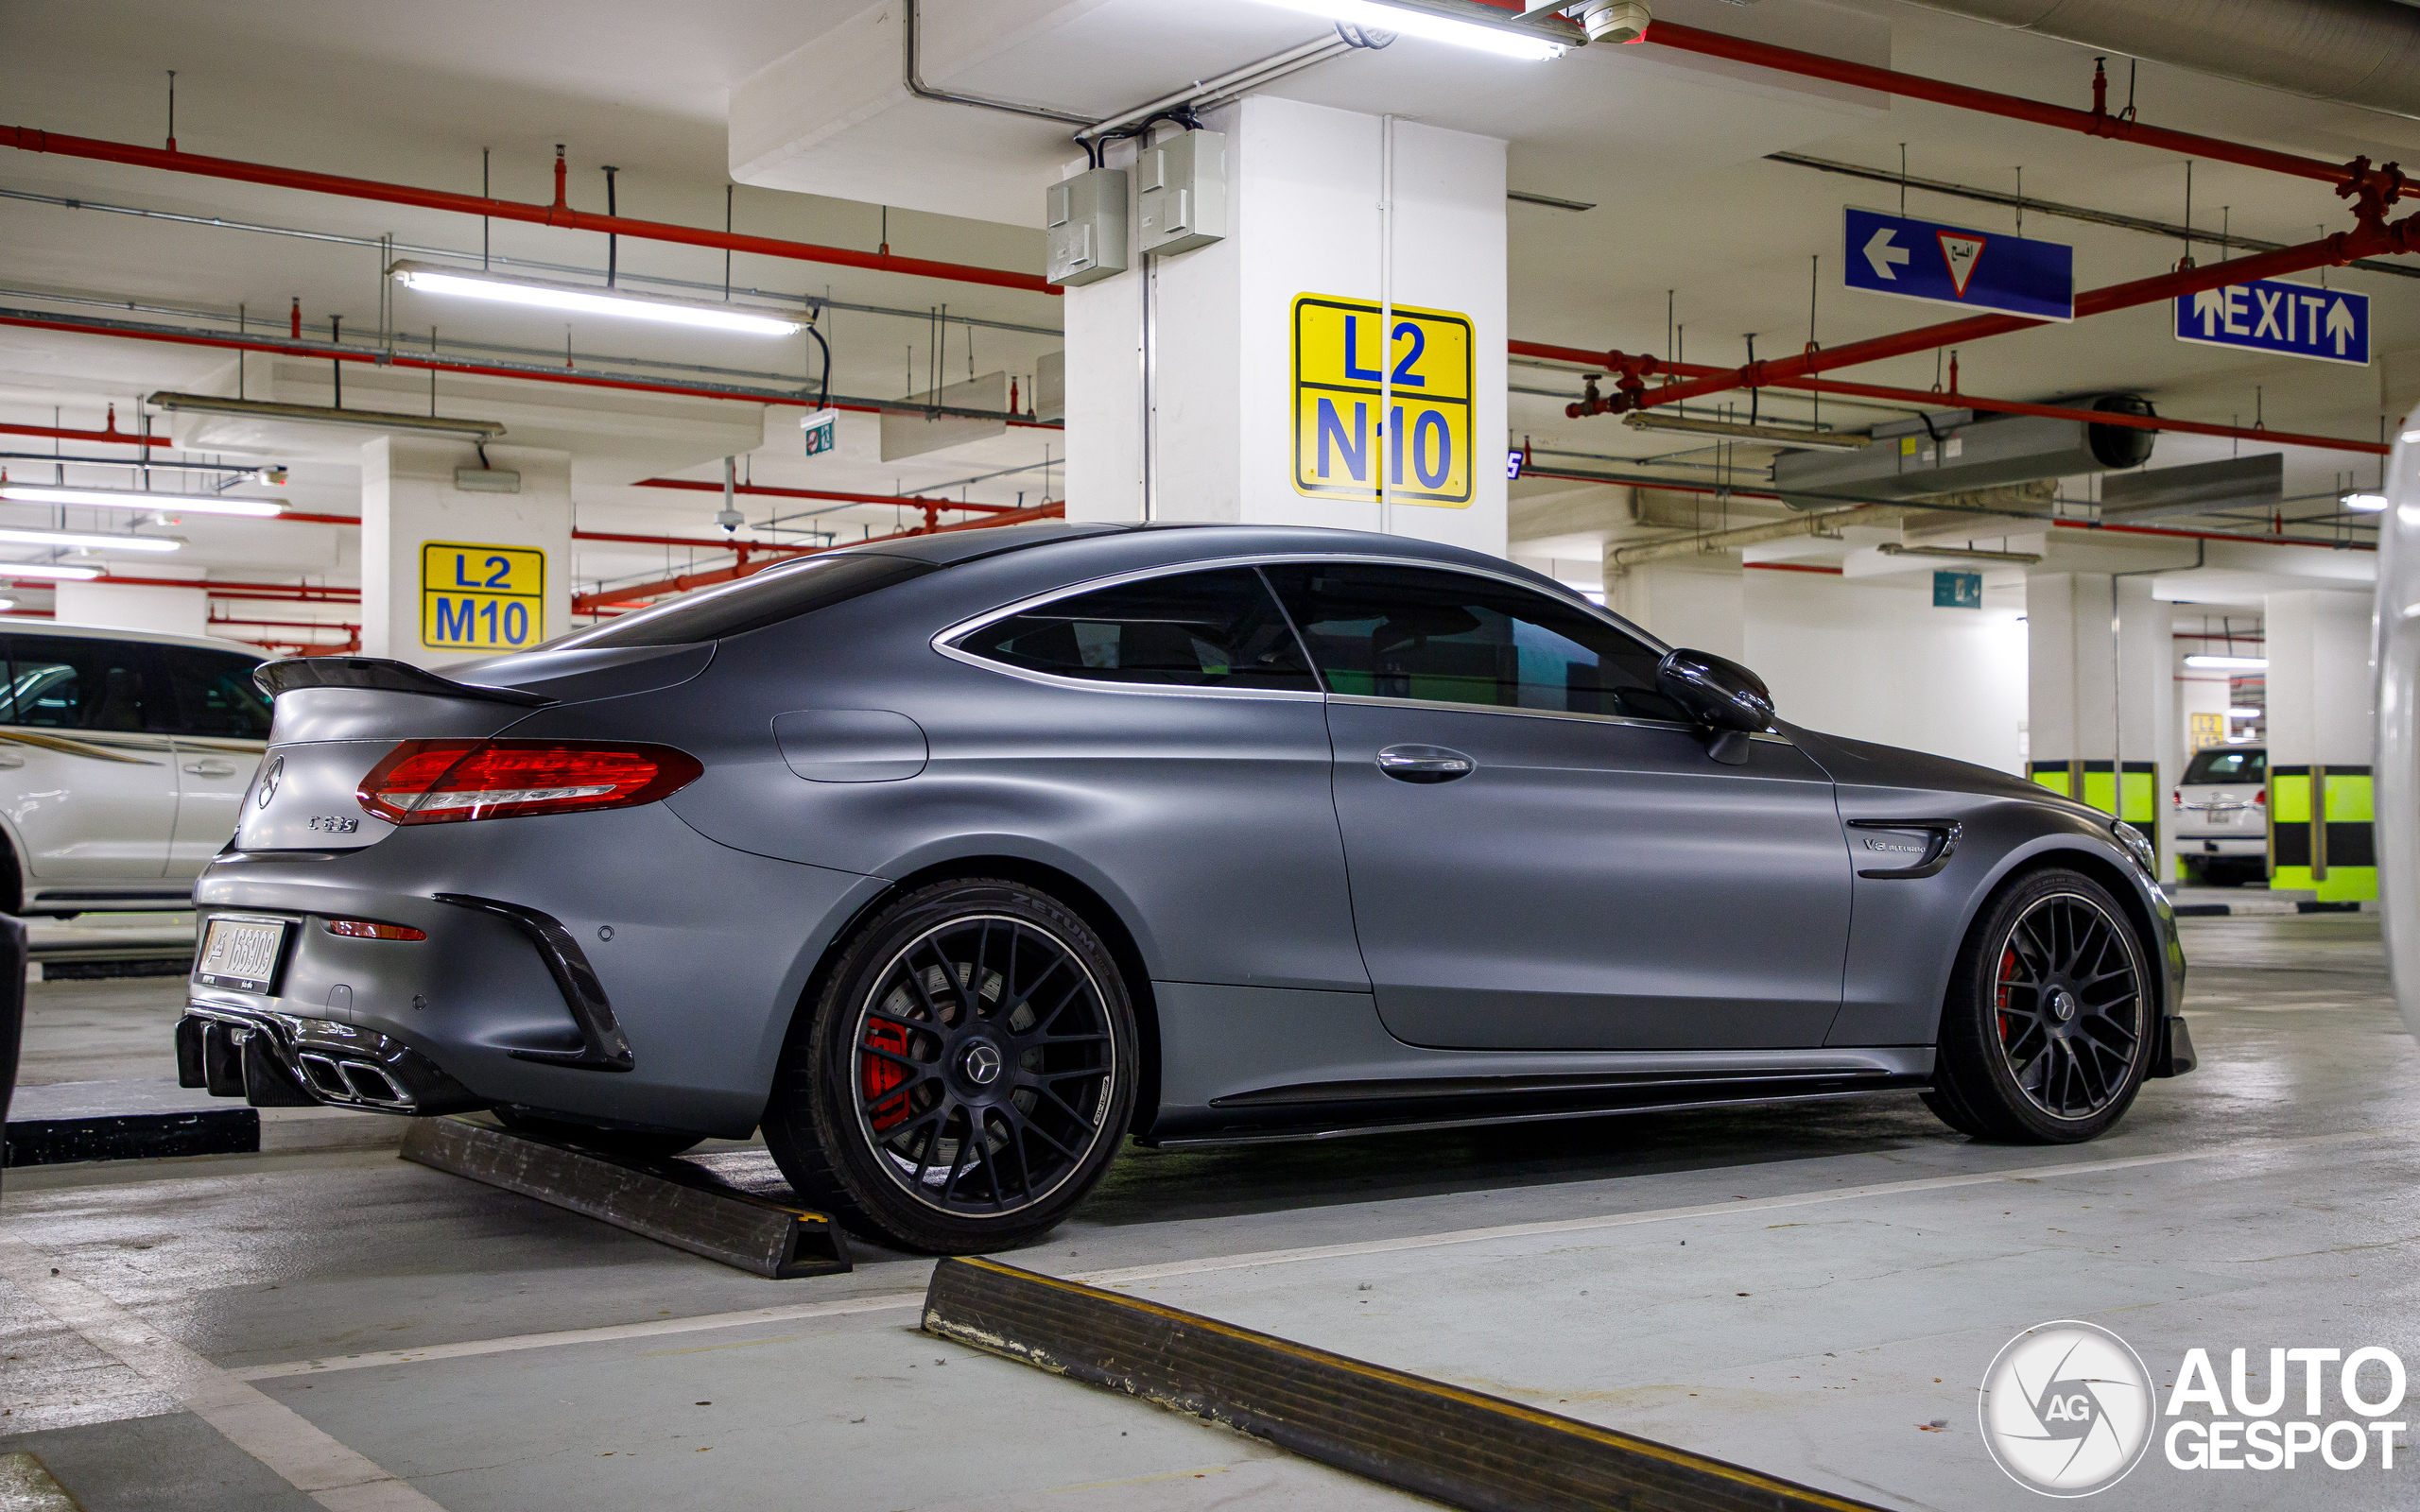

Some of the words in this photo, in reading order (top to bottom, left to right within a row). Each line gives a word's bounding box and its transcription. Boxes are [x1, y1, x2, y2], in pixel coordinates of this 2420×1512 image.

[2224, 284, 2325, 346] EXIT
[1344, 315, 1426, 387] L2
[1317, 397, 1452, 490] N10
[456, 554, 511, 590] L2
[437, 596, 529, 645] M10
[1863, 838, 1887, 851] V8
[1888, 845, 1926, 854] BITURBO
[1011, 892, 1096, 954] ZETUM
[226, 927, 277, 977] 166909
